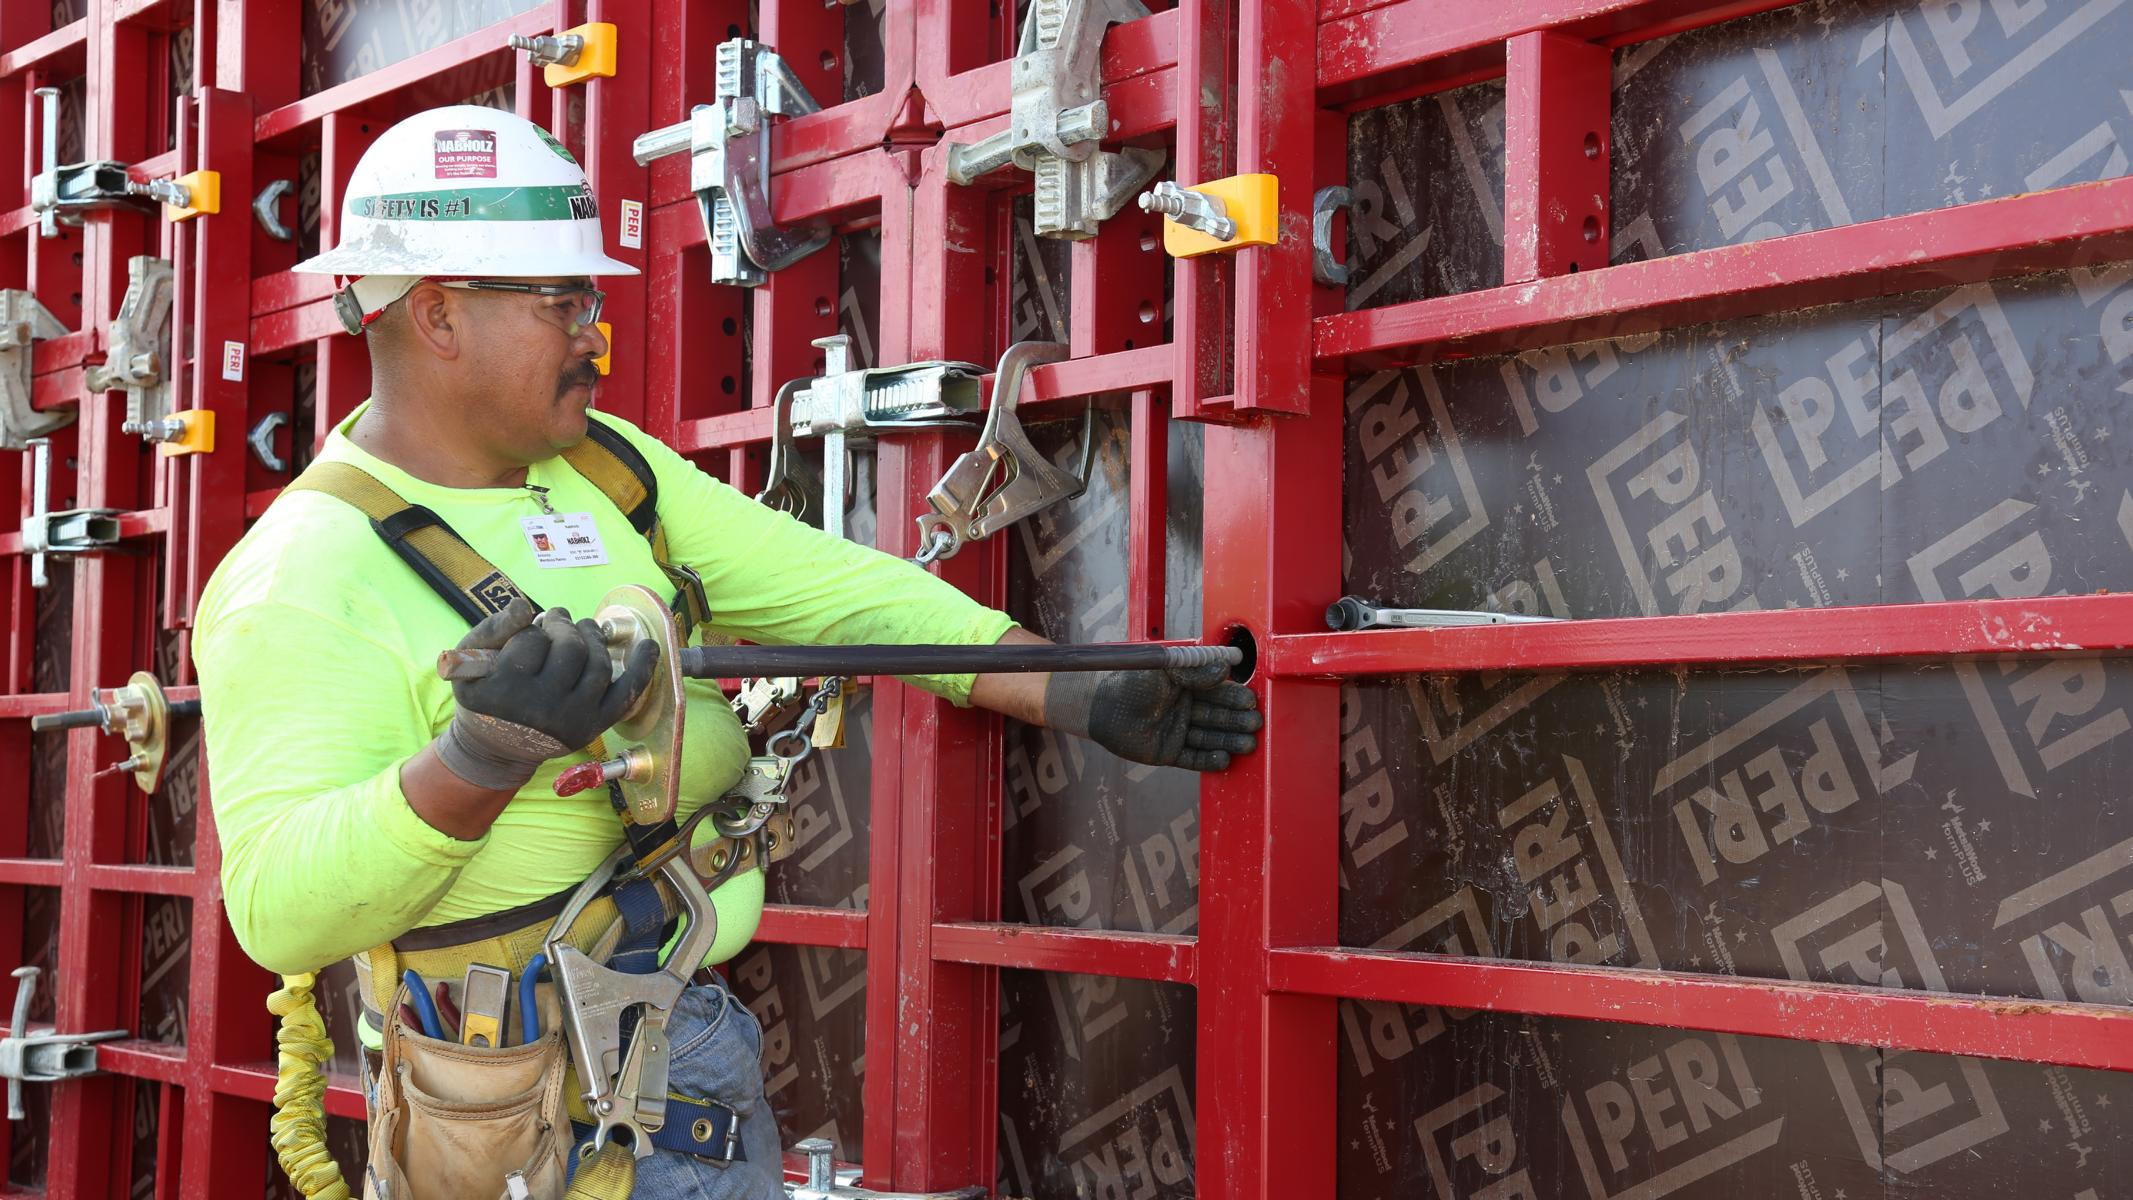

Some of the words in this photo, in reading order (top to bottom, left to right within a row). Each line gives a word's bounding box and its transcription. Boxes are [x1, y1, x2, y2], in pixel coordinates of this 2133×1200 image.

[457, 155, 492, 163] PURPOSE
[1679, 75, 1797, 246] ERI
[420, 199, 439, 218] IS
[445, 197, 470, 216] #1
[628, 207, 640, 239] PERI
[229, 348, 241, 372] PERI
[1627, 437, 1757, 609] PER
[1672, 716, 1861, 887] PERI
[1586, 1033, 1762, 1174] PERI
